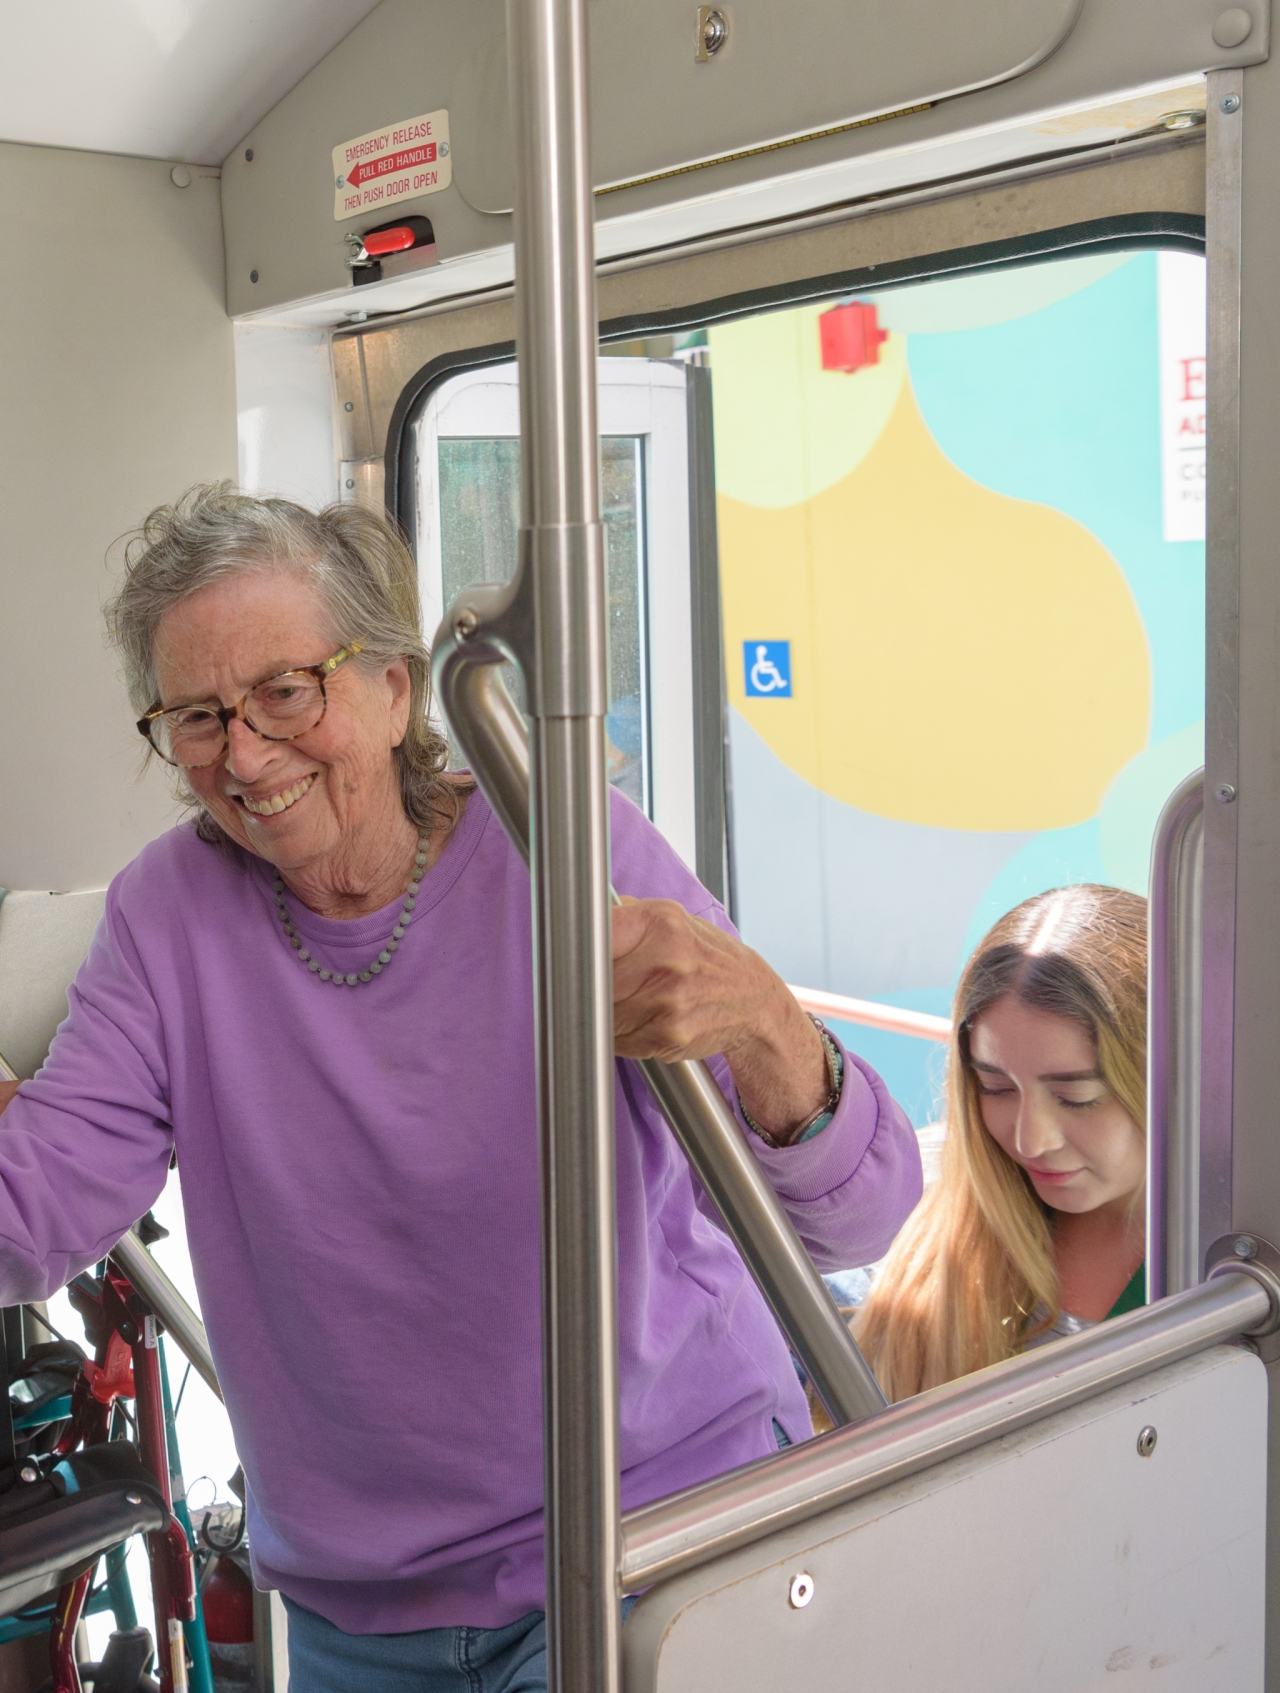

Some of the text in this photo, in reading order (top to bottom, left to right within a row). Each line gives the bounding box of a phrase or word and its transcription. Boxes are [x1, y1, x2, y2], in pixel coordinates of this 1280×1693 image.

[345, 121, 432, 163] EMERGENCY RELEASE
[359, 147, 432, 179] PULL RED HANDLE
[344, 170, 438, 211] THEN PUSH DOOR OPEN
